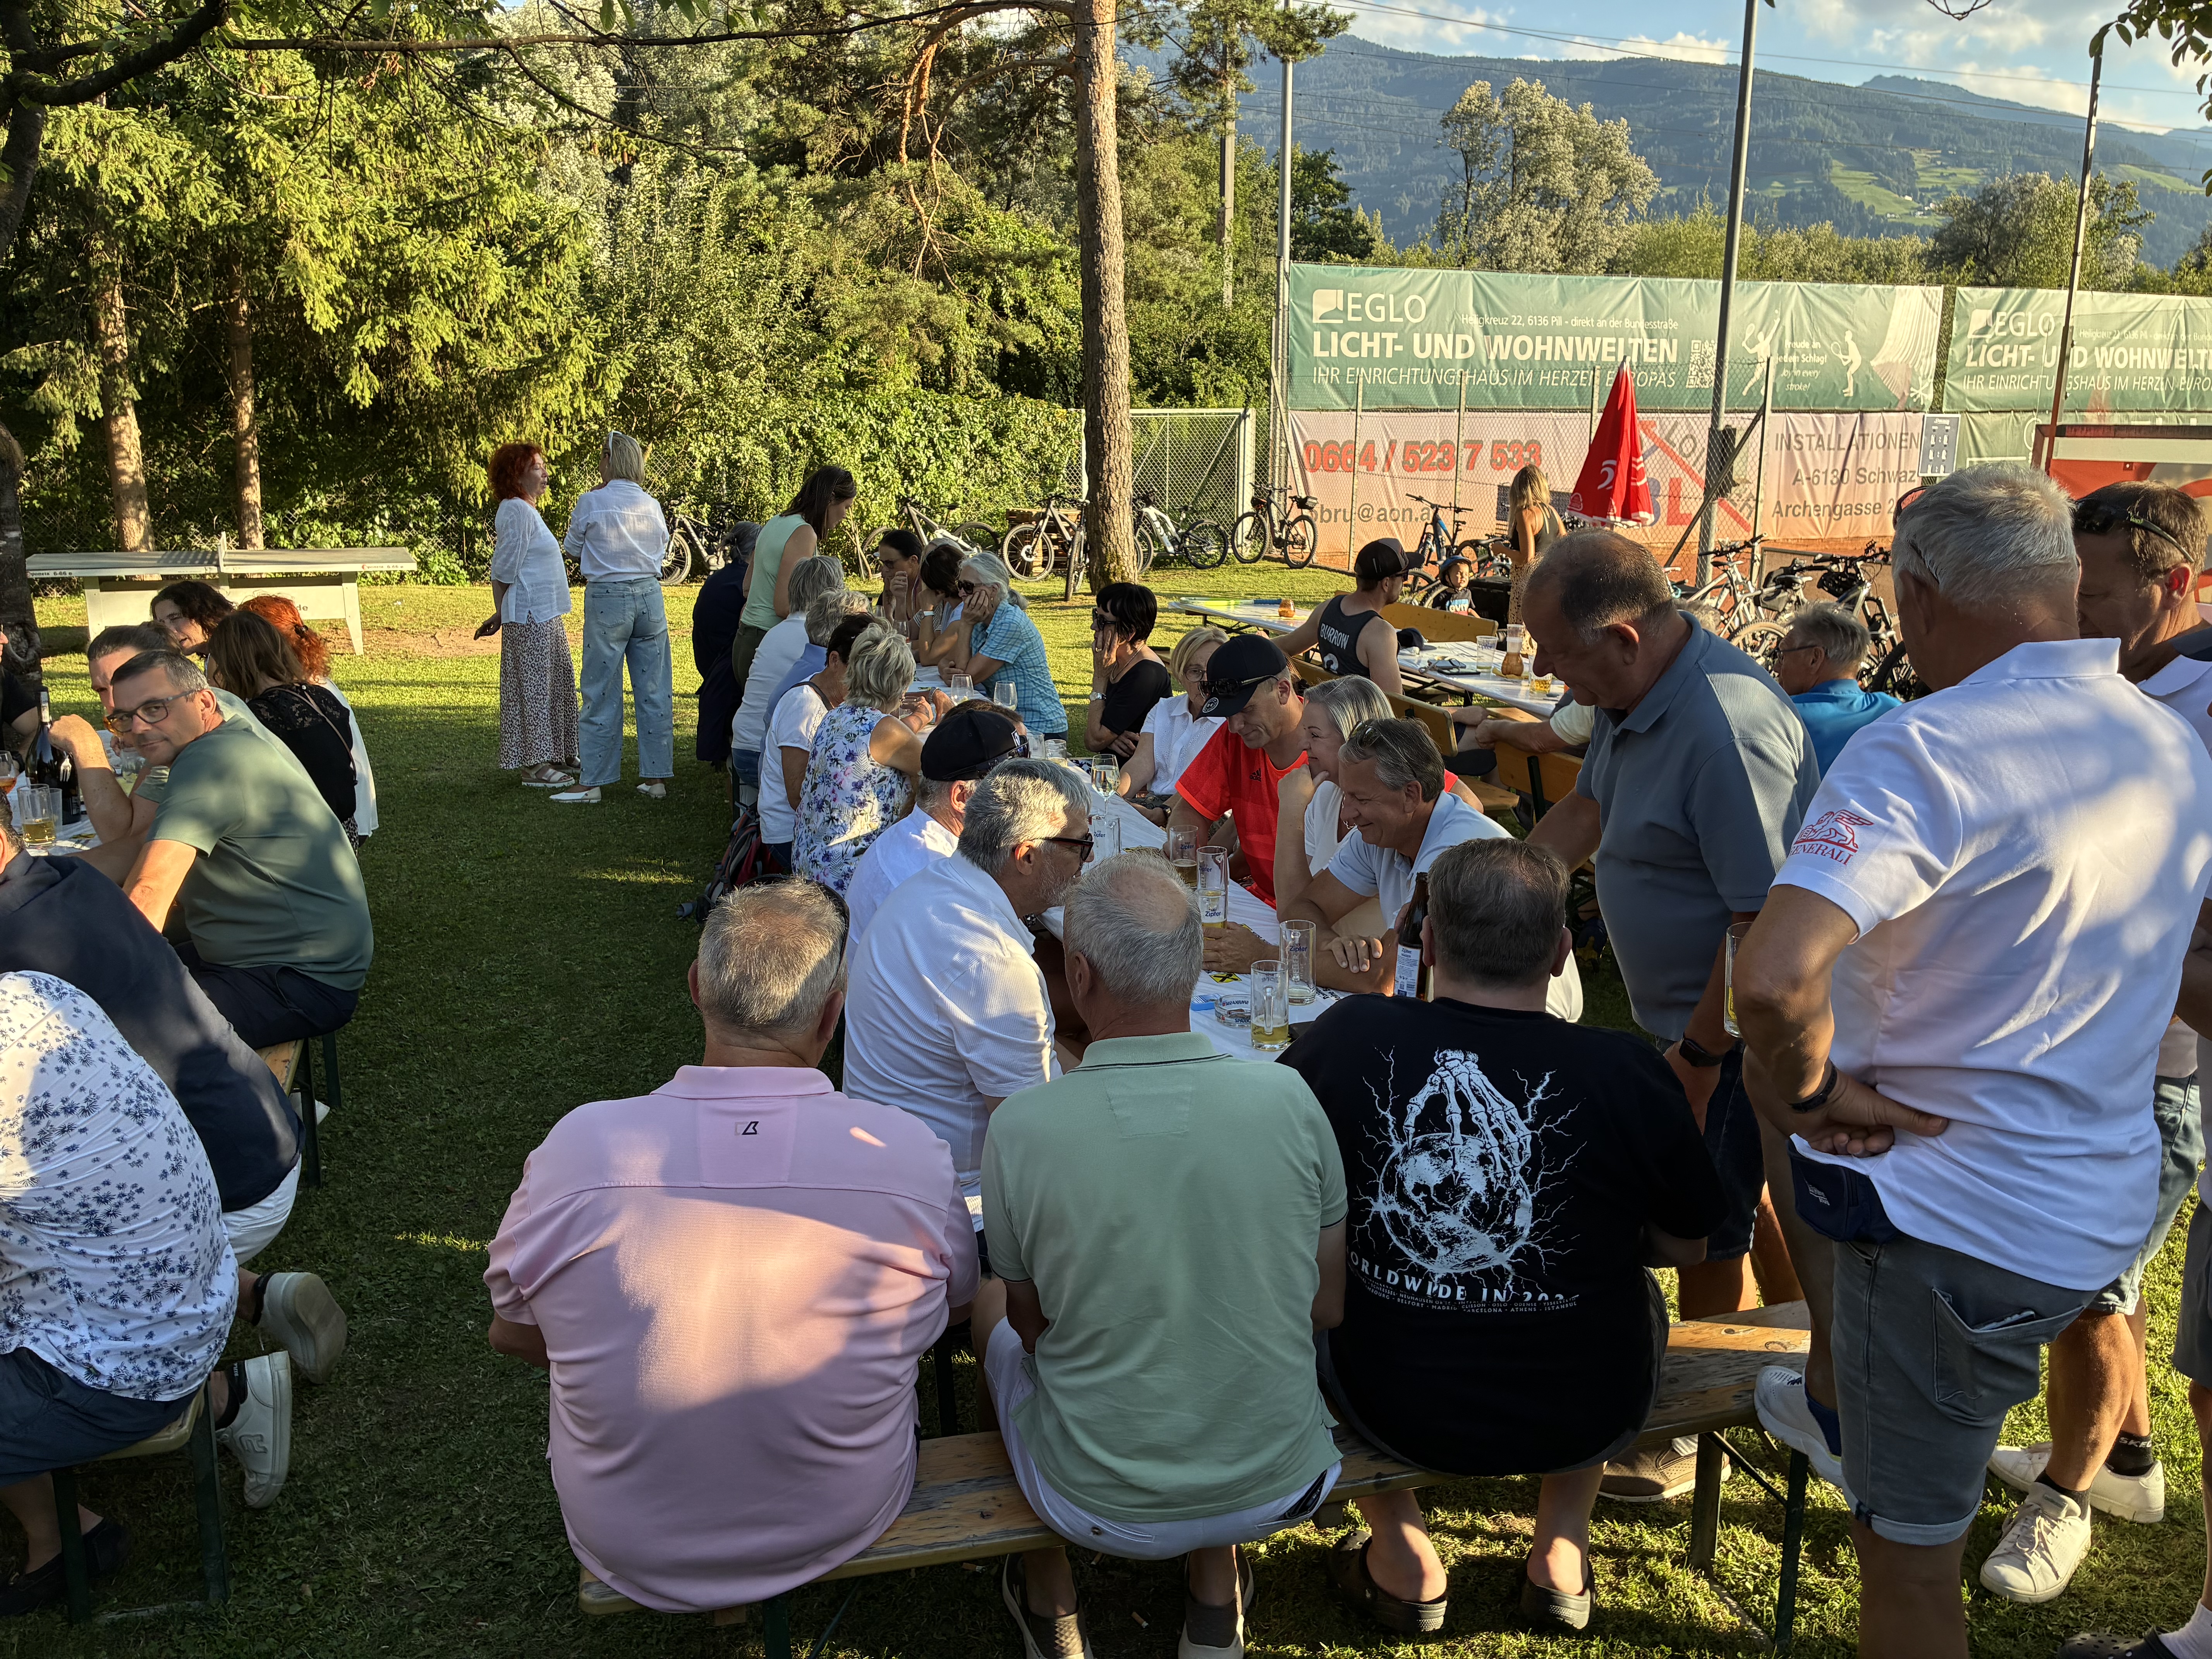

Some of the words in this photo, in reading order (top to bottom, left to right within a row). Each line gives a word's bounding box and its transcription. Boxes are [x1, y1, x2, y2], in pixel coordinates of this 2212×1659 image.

[1347, 293, 1426, 323] EGLO
[1462, 314, 1509, 328] Heiligkreuz
[1511, 315, 1525, 327] 22,
[1527, 315, 1549, 326] 6136
[1551, 316, 1562, 326] Pill
[1571, 316, 1594, 327] direkt
[1596, 319, 1607, 327] an
[1609, 317, 1623, 328] der
[1625, 318, 1678, 329] Bundesstraße
[1995, 311, 2055, 337] EGLO
[1313, 331, 1403, 358] LICHT-
[1413, 333, 1475, 359] UND
[1484, 335, 1678, 363] WOHNWELTEN
[1965, 344, 2035, 367] LICHT-
[1313, 367, 1340, 384] IHR
[1513, 369, 1533, 386] IM
[1606, 371, 1676, 388] EOPAS
[1963, 375, 1984, 390] IHR
[1989, 375, 2111, 391] EINRICHTUGSHAUS
[2114, 376, 2128, 390] IM
[2179, 376, 2212, 391] EURO
[1775, 433, 1920, 451] INSTALLATIONEN
[1304, 440, 1377, 472] 0664
[1402, 440, 1456, 472] 523
[1490, 440, 1542, 471] 533
[1792, 469, 1850, 485] A-6130
[1856, 467, 1916, 485] Schwaz
[1772, 500, 1882, 521] Archengasse
[1320, 623, 1349, 650] BURROW
[1347, 1245, 1465, 1300] ORLDWIDE
[1482, 1288, 1506, 1302] IN
